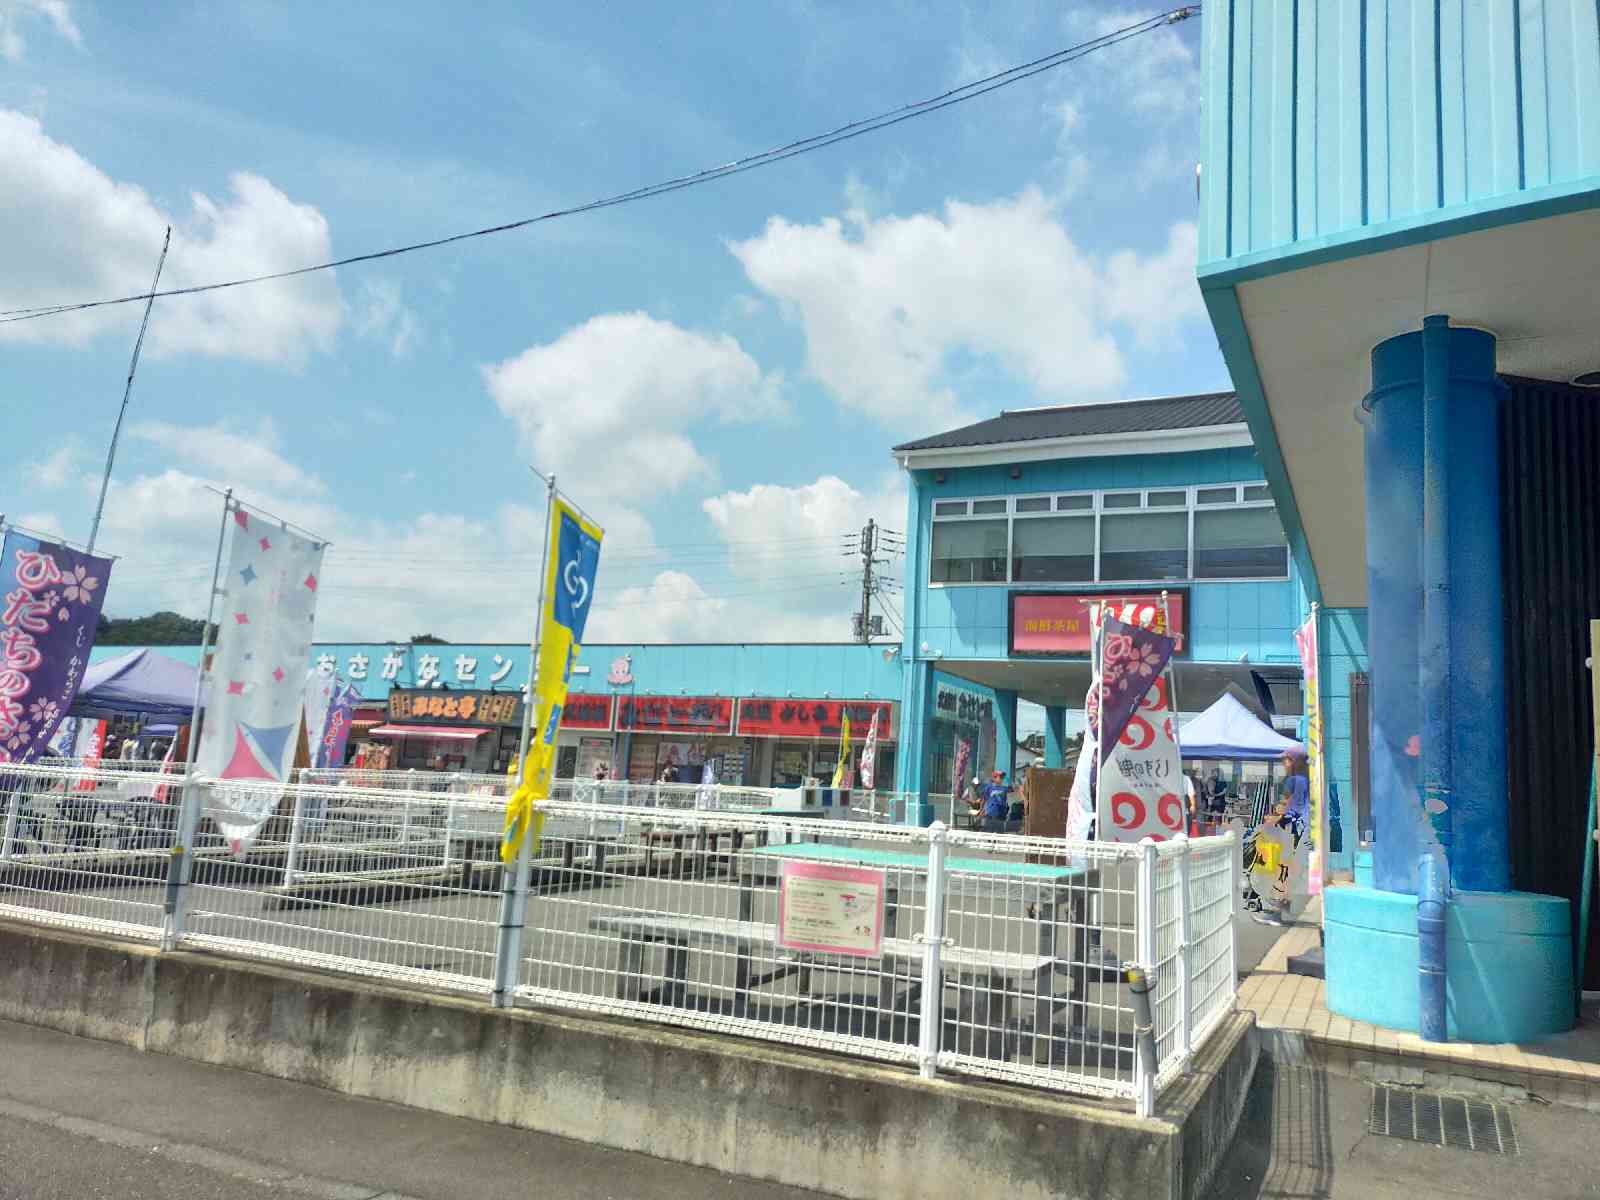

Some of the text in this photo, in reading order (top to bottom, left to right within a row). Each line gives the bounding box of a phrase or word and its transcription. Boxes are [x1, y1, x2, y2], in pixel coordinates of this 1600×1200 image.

[318, 651, 590, 682] おさかなセンー
